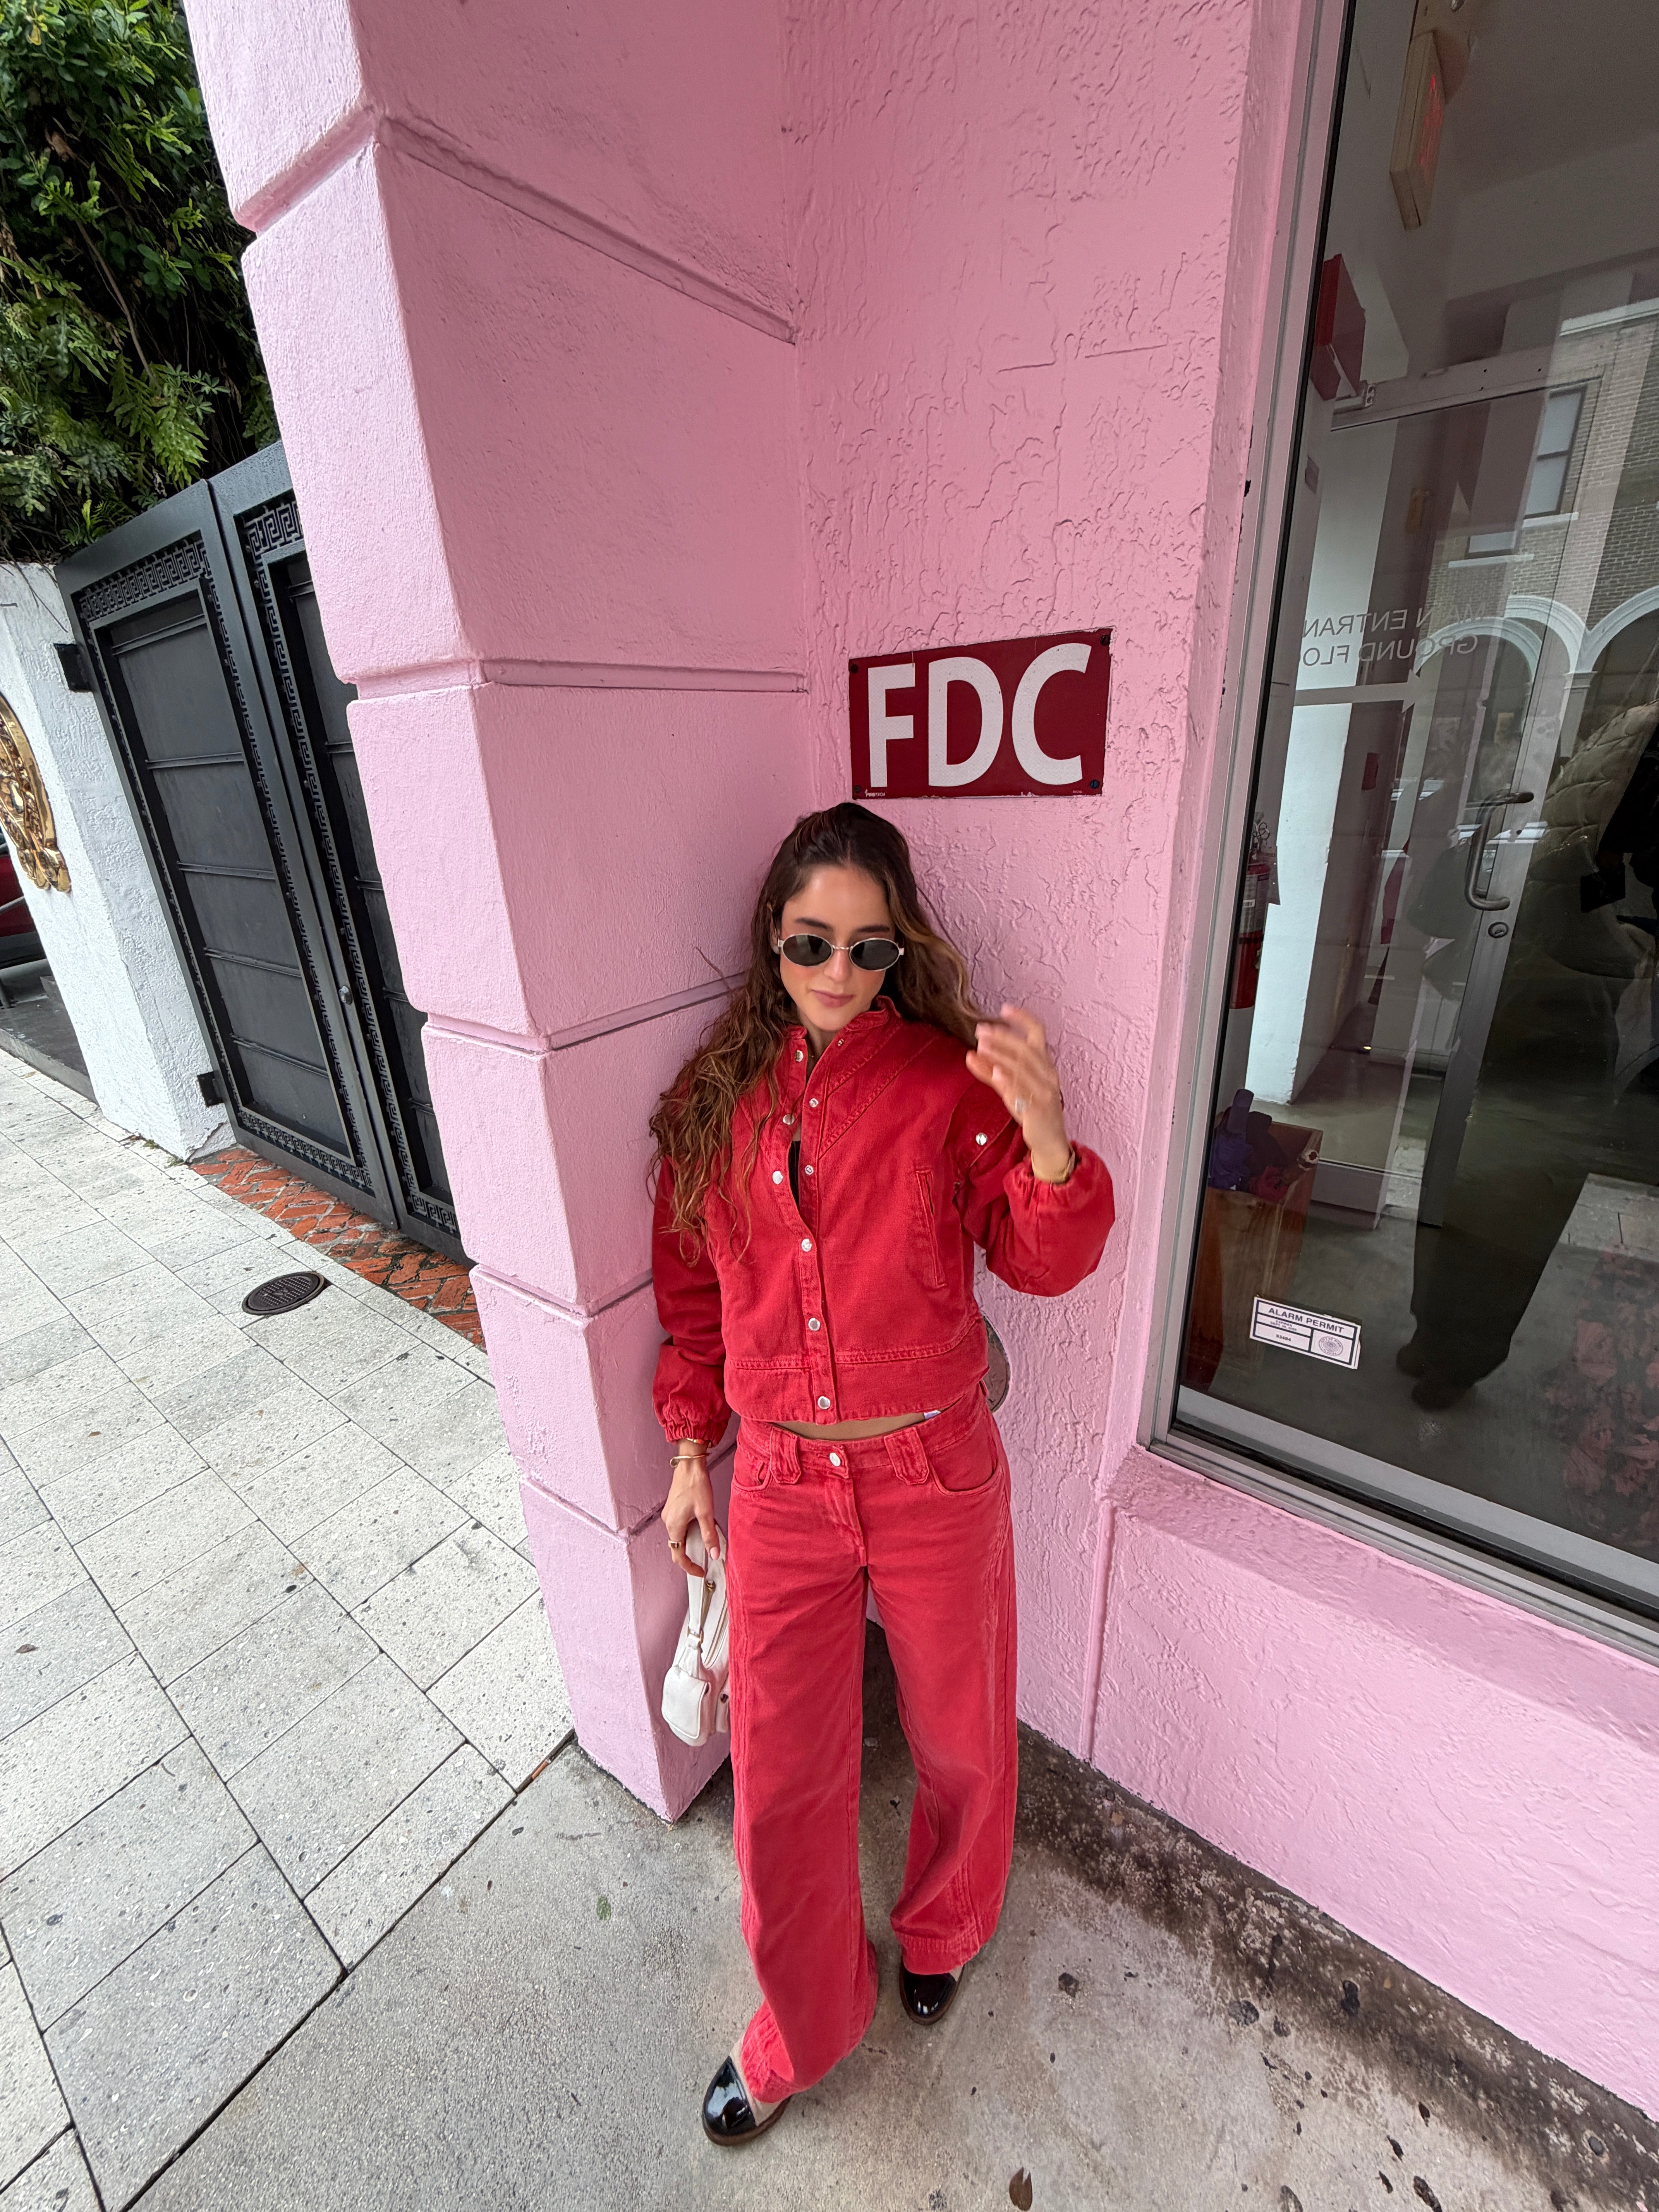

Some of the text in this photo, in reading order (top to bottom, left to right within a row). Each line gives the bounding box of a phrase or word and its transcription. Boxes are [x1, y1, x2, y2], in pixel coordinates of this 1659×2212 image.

[868, 643, 1092, 787] FDC
[1269, 1308, 1344, 1333] ALARM PERMIT
